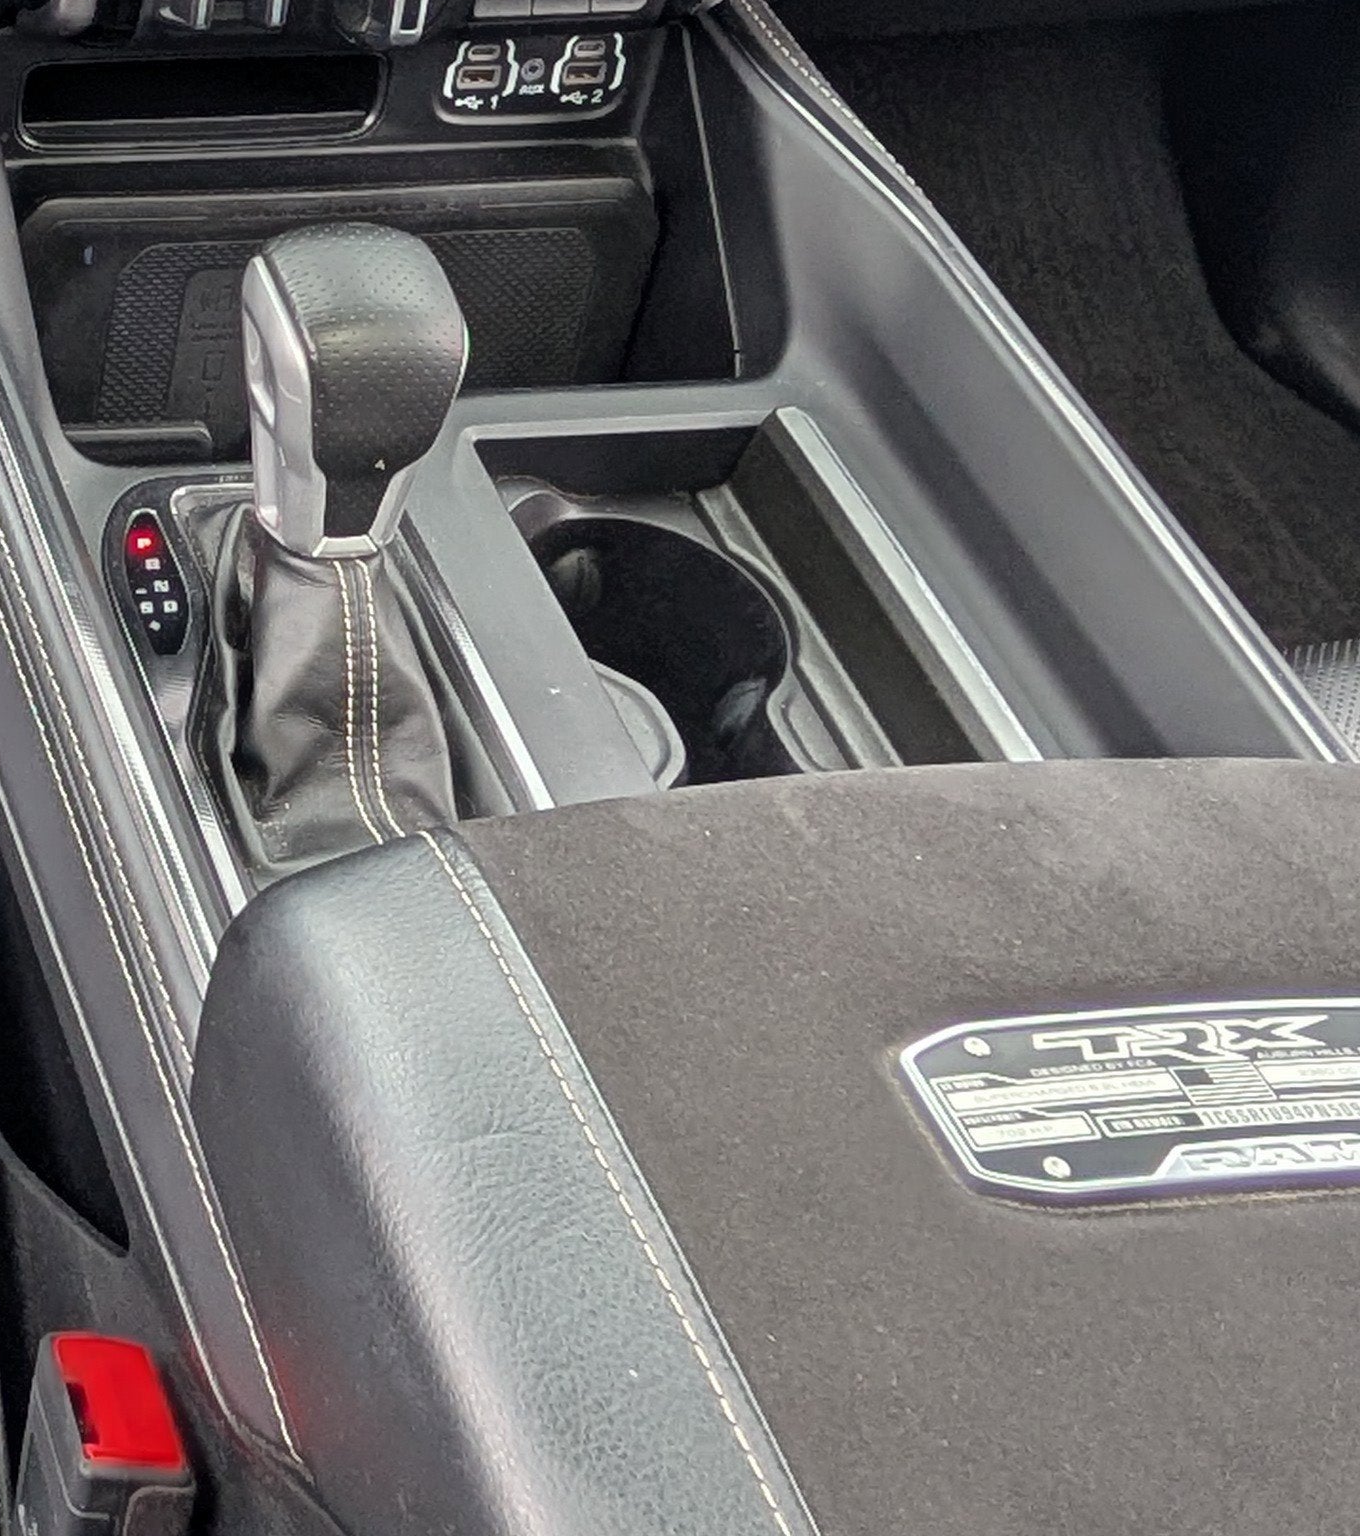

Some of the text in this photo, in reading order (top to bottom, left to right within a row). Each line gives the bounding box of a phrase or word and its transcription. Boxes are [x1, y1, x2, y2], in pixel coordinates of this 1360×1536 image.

[490, 95, 500, 110] 1
[591, 90, 603, 104] 2
[1033, 1015, 1329, 1063] TRX
[1030, 1059, 1158, 1078] DESIGNED BY FCA
